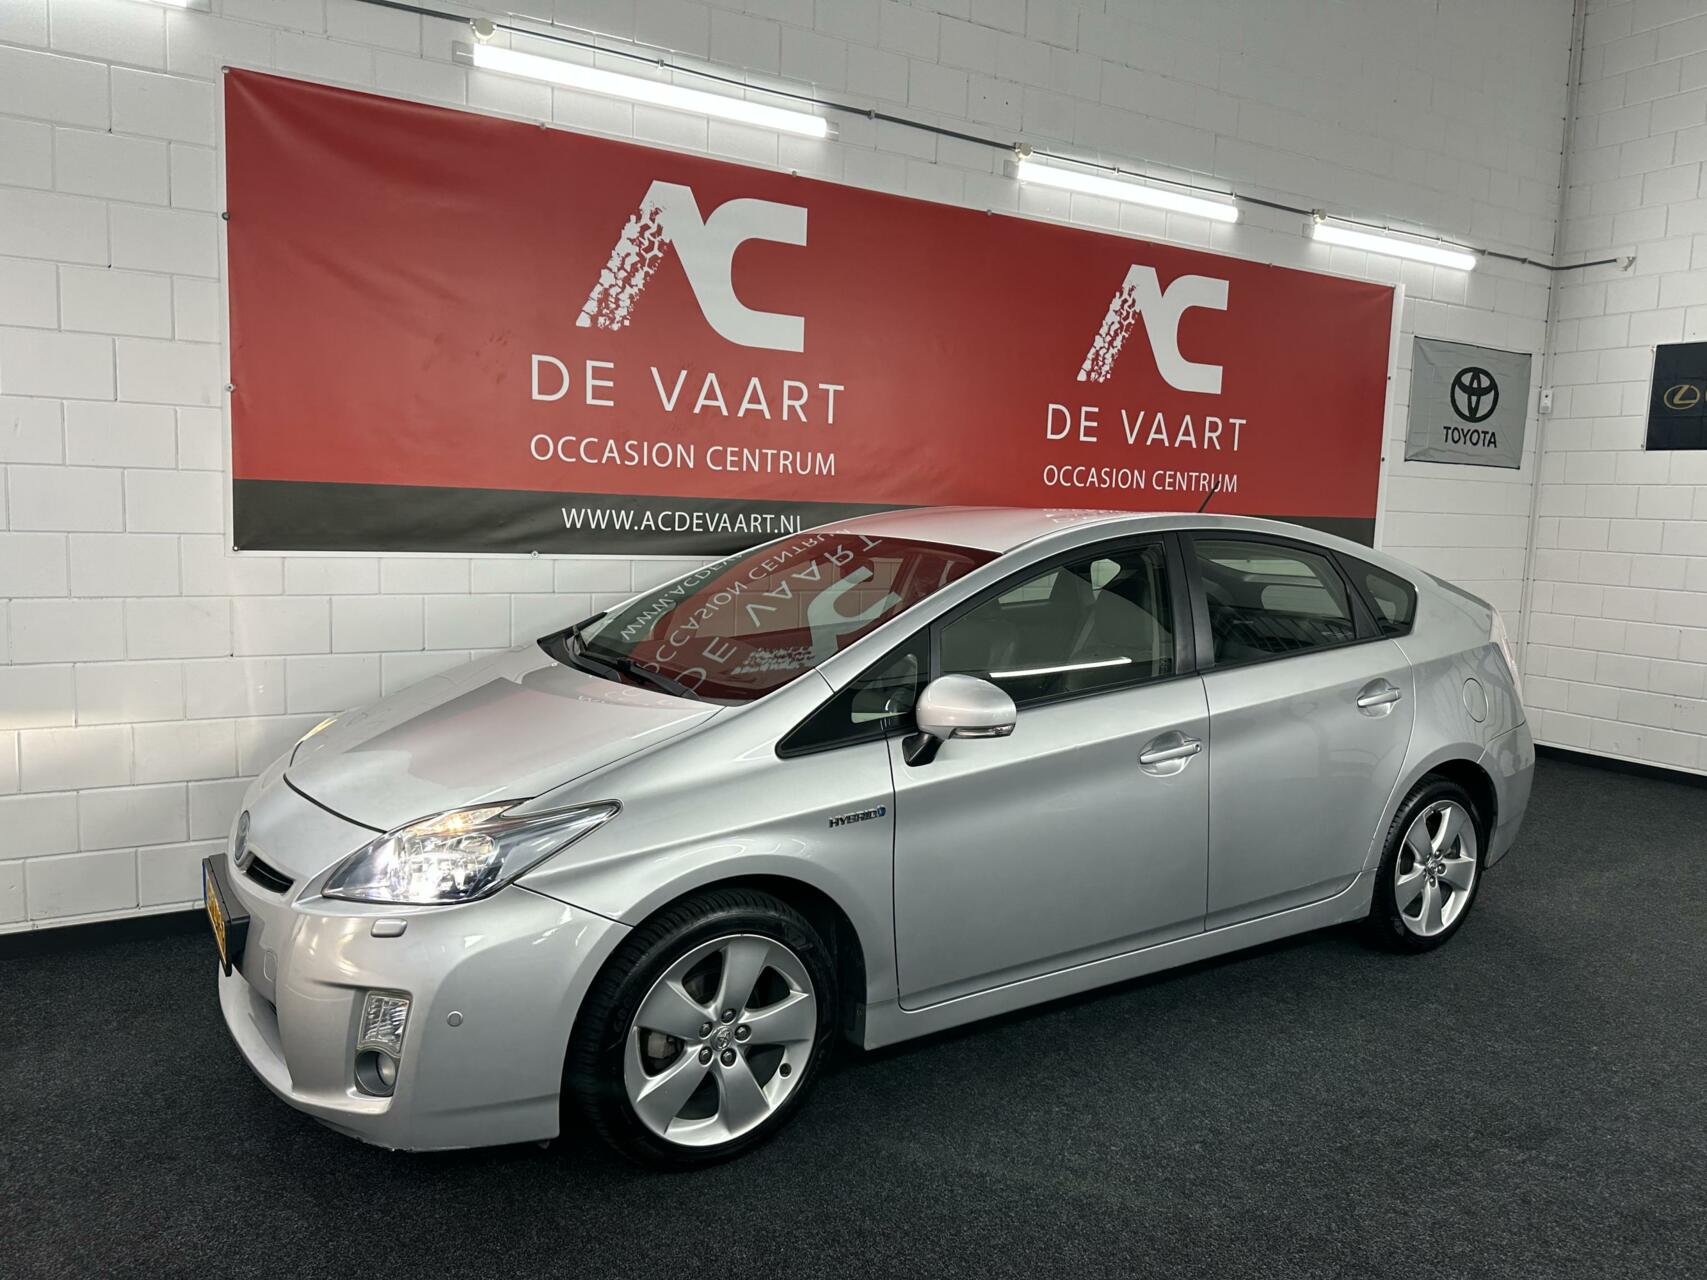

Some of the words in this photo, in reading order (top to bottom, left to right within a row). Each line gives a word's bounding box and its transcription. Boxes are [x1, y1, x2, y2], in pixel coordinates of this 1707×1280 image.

[531, 353, 615, 407] DE
[650, 366, 845, 425] VAART
[1046, 403, 1099, 442] DE
[1121, 409, 1247, 451] VAART
[1443, 426, 1497, 448] TOYOTA
[530, 433, 695, 469] OCCASION
[706, 445, 836, 476] CENTRUM
[1043, 464, 1146, 489] OCCASION
[1152, 470, 1238, 493] CENTRUM
[829, 809, 878, 828] HYBRID
